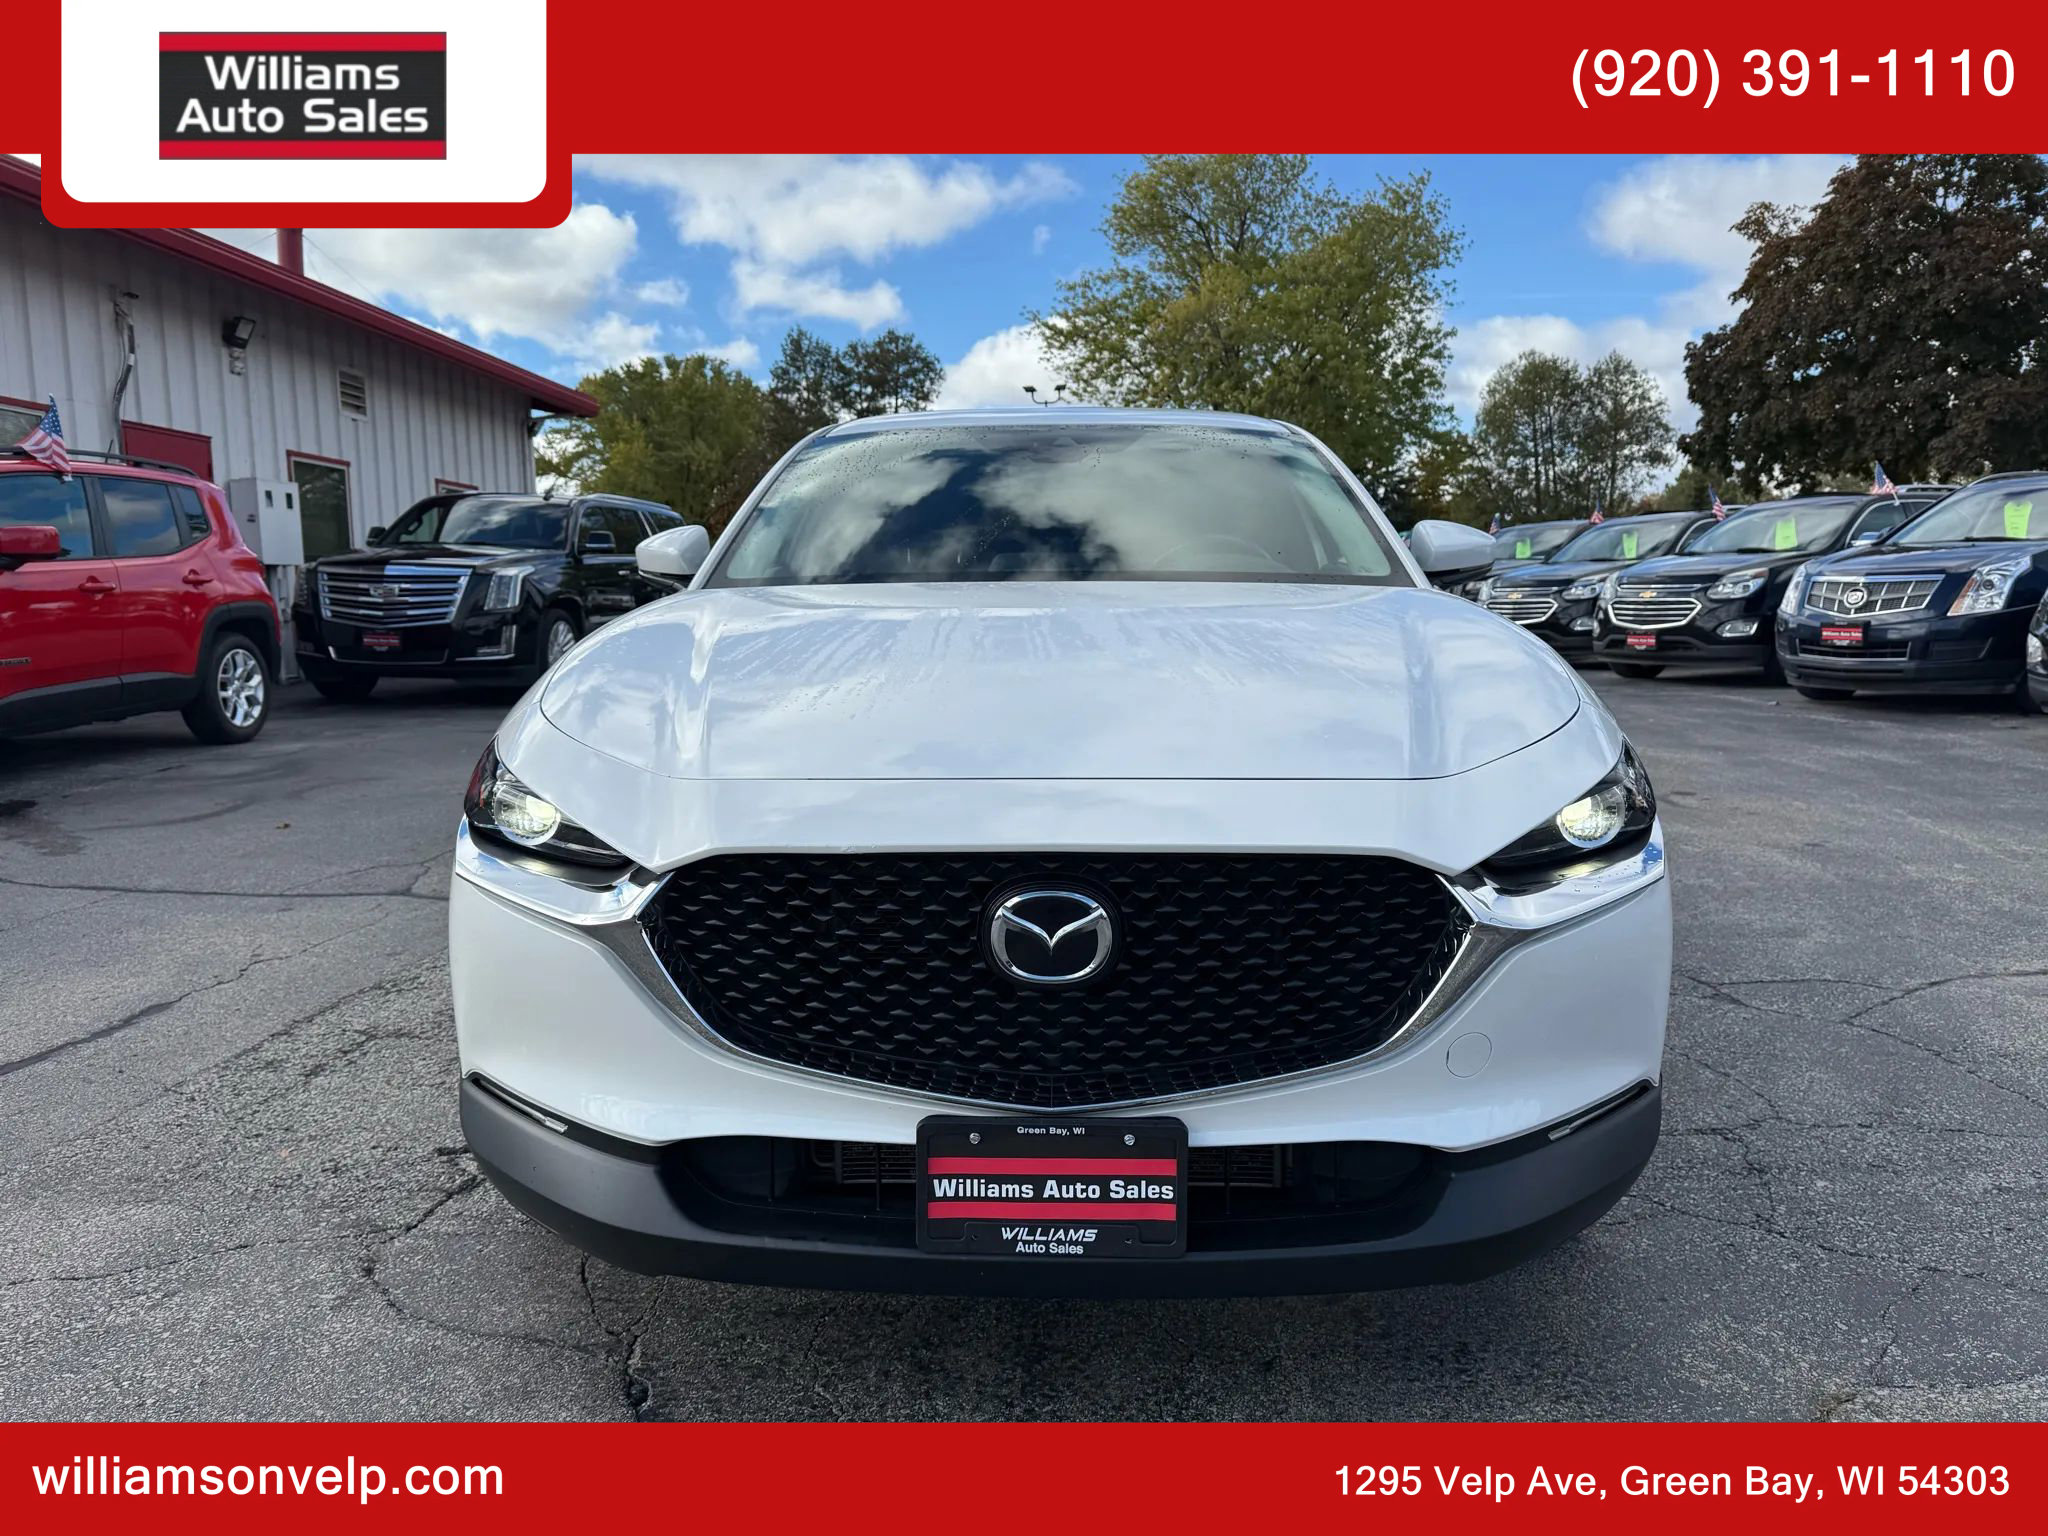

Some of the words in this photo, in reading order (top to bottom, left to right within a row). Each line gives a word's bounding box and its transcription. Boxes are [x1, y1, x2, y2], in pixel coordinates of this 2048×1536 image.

[1016, 1126, 1046, 1135] Green
[1049, 1126, 1070, 1136] Bay,
[1073, 1127, 1086, 1135] WI
[933, 1178, 1034, 1198] Williams
[1042, 1179, 1101, 1199] Auto
[1109, 1179, 1174, 1200] Sales
[1001, 1226, 1099, 1242] WILLIAMS
[1015, 1241, 1046, 1254] Auto
[1049, 1242, 1084, 1255] Sales
